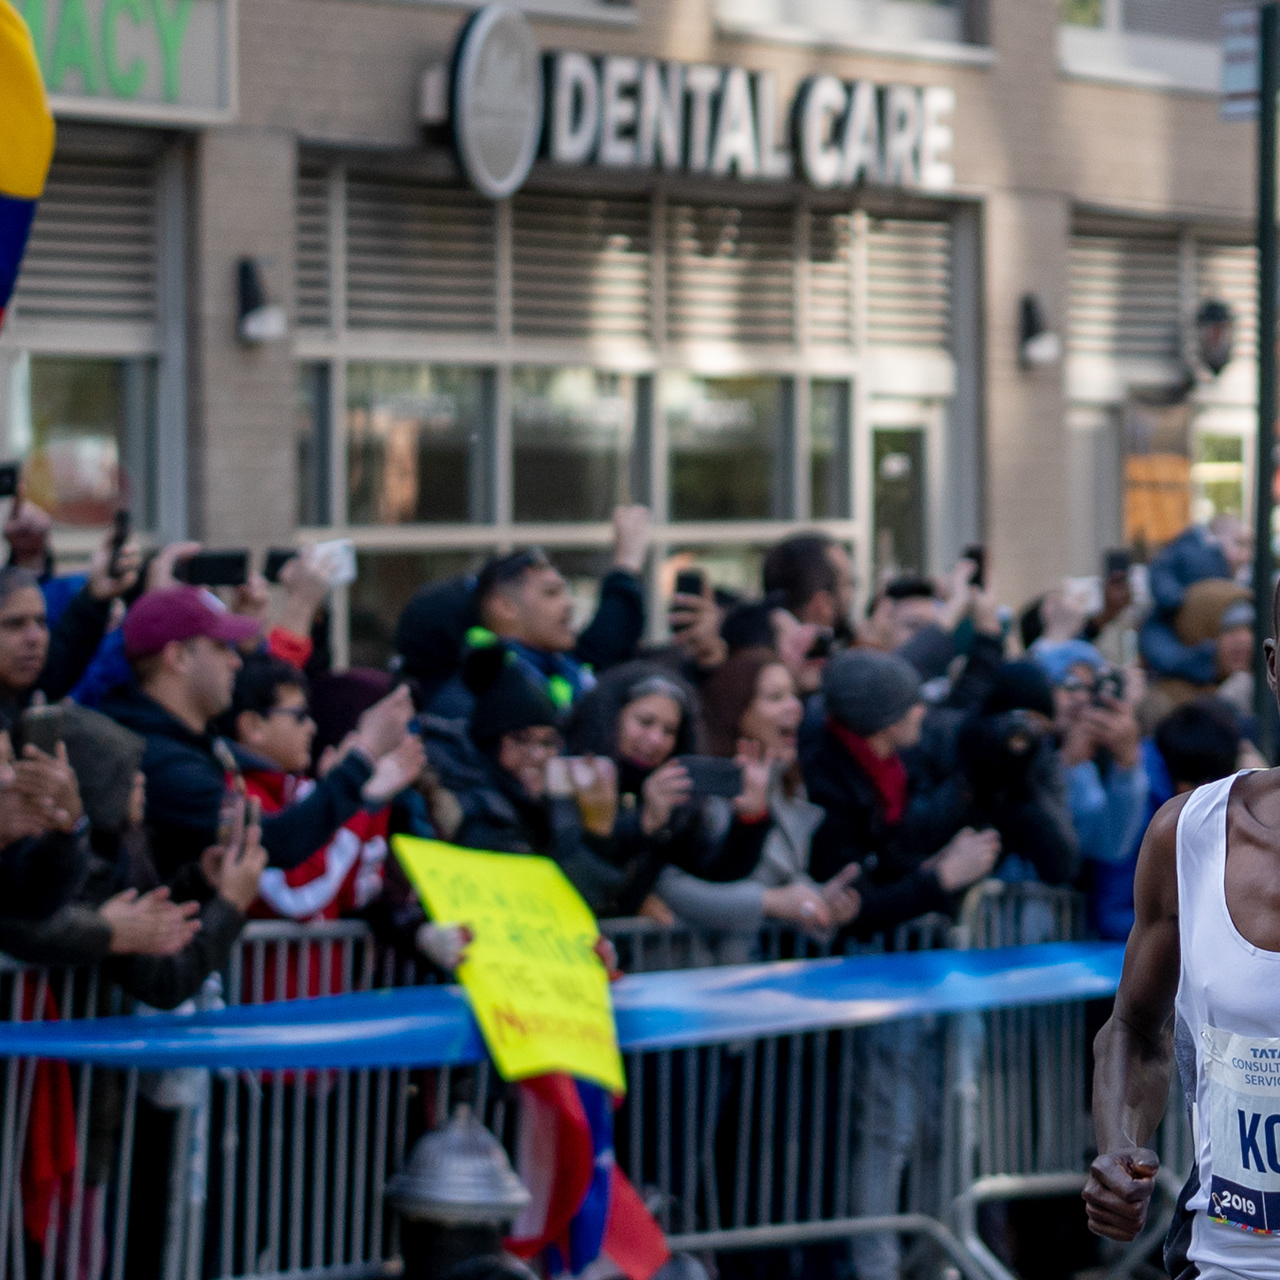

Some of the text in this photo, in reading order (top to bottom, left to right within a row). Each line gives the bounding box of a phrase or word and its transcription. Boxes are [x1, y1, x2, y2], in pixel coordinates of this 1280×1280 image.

[553, 51, 956, 190] DENTAL CARE
[1221, 1190, 1257, 1215] 2019
